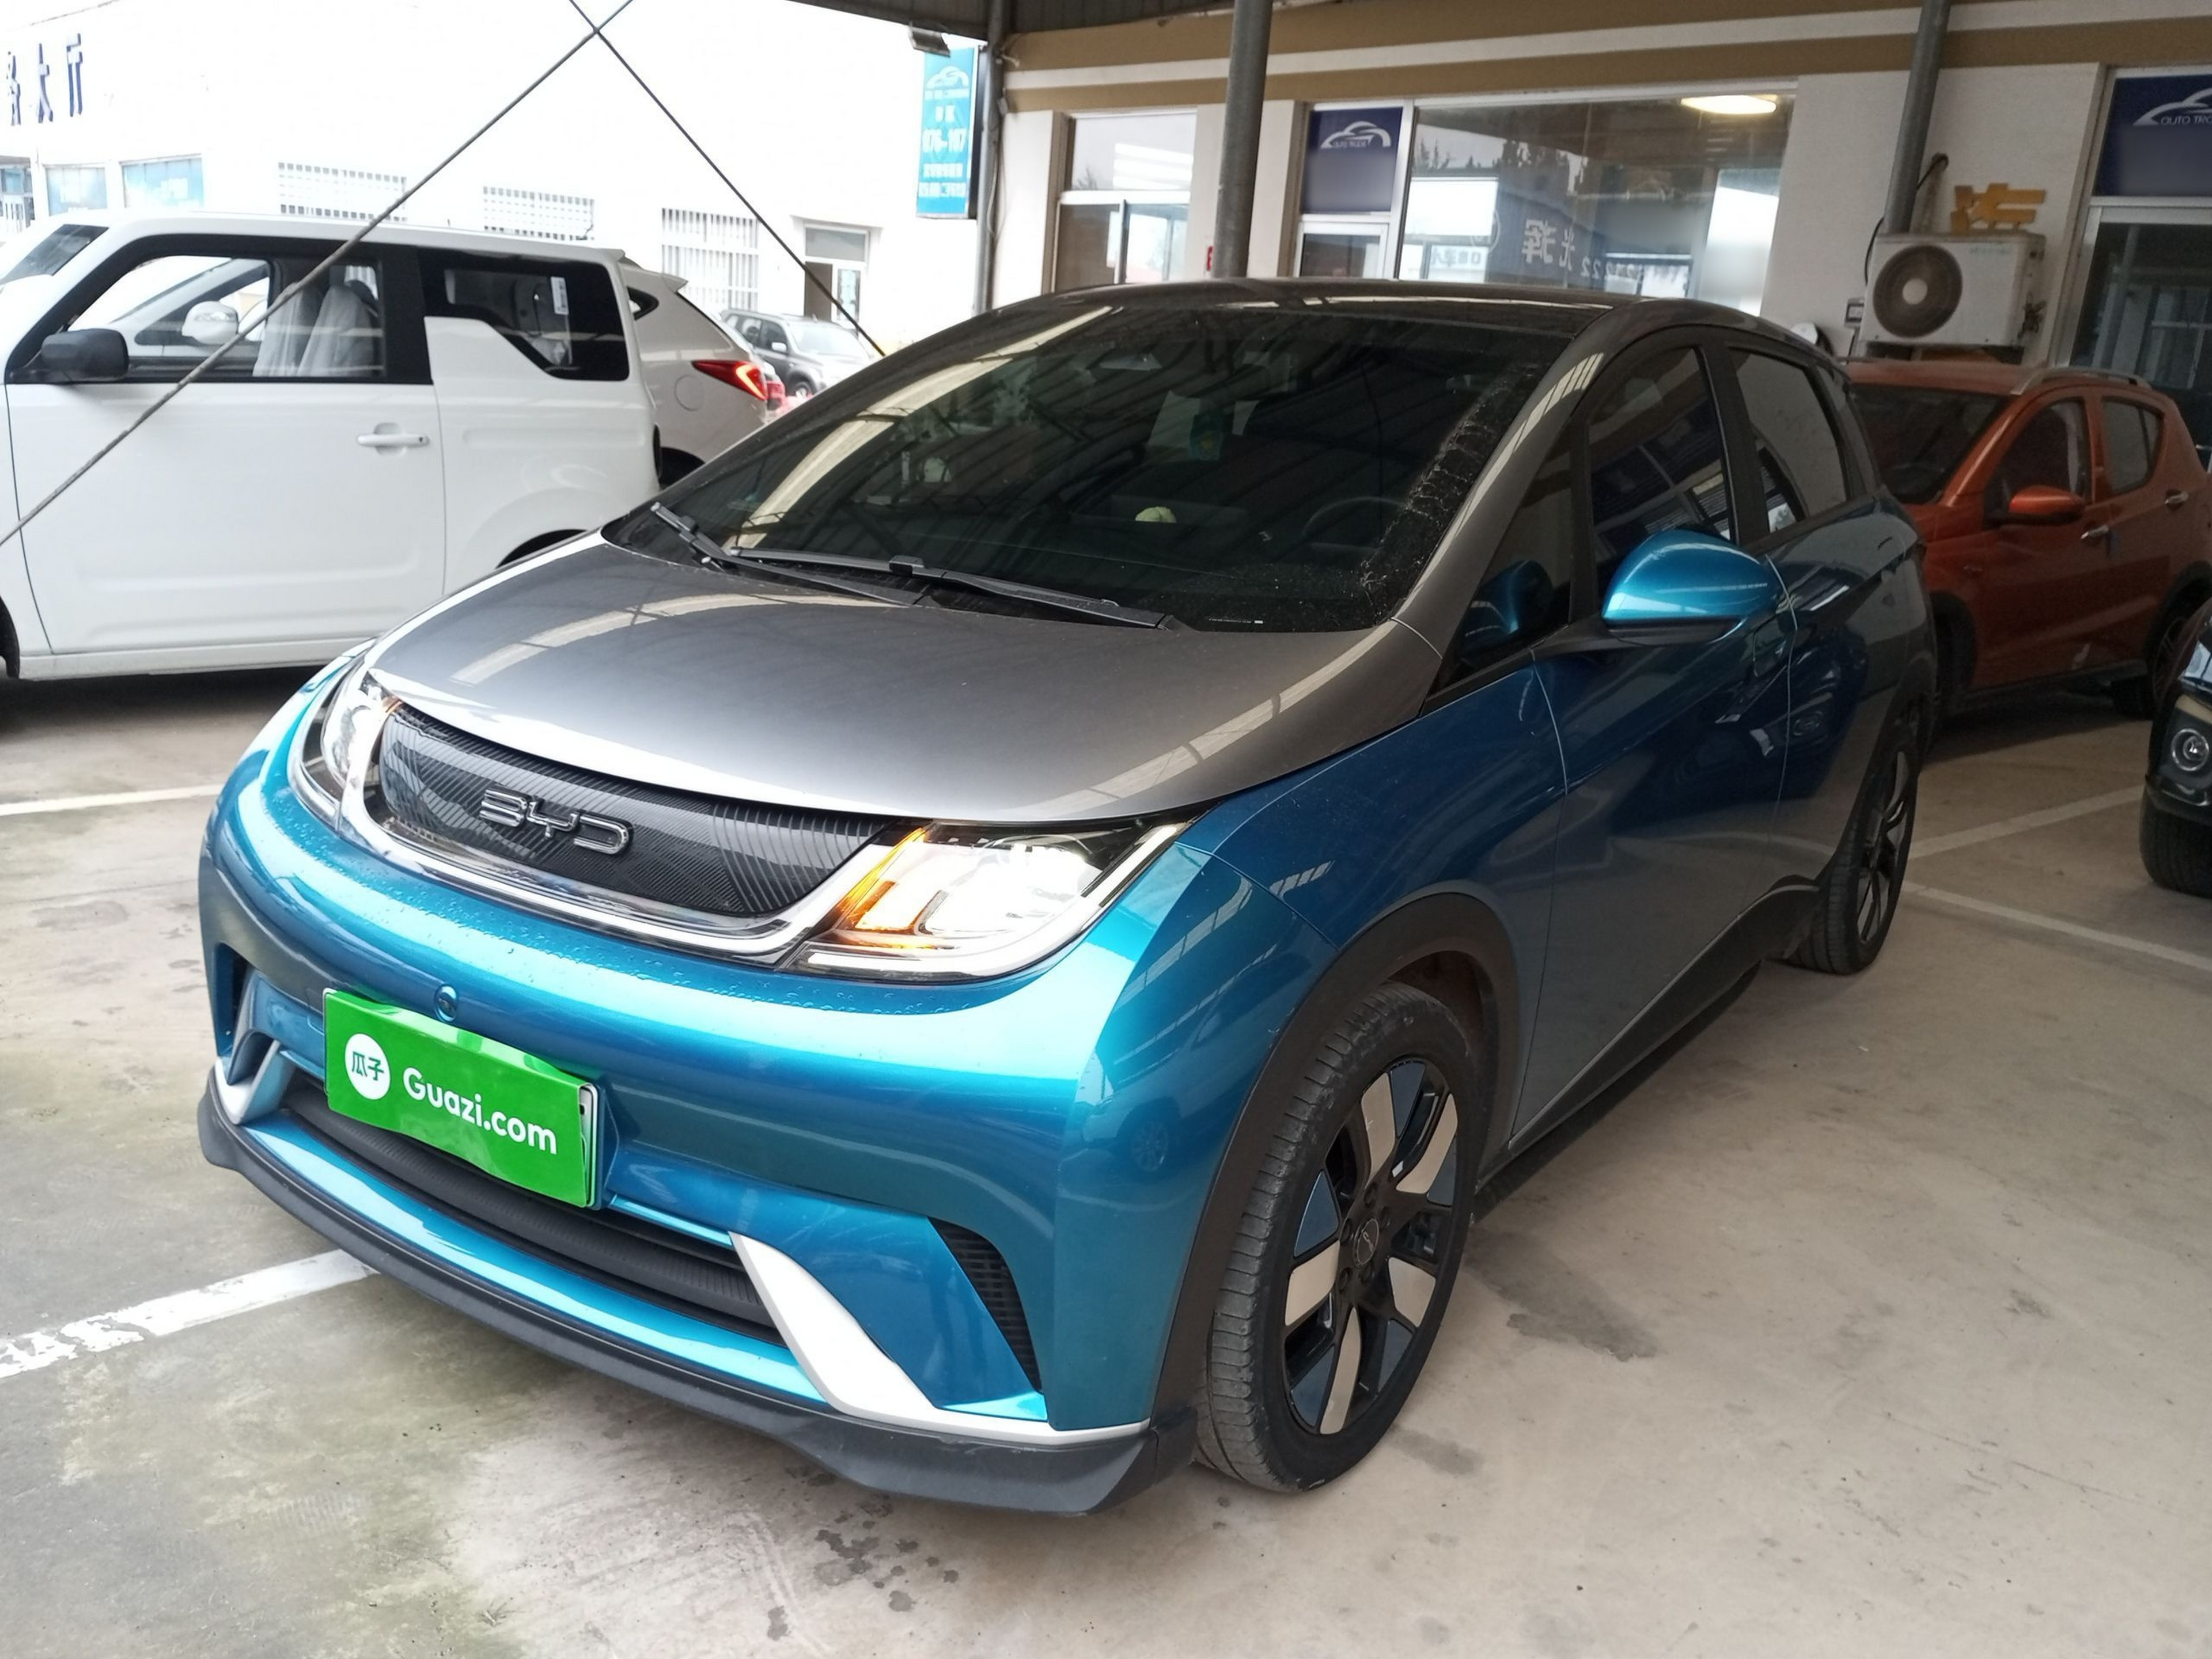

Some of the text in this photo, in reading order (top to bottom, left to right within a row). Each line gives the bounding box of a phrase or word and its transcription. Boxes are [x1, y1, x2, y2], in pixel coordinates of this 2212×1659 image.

[479, 788, 630, 855] BYD
[352, 1051, 384, 1081] 瓜子
[403, 1067, 556, 1155] Guazi.com
